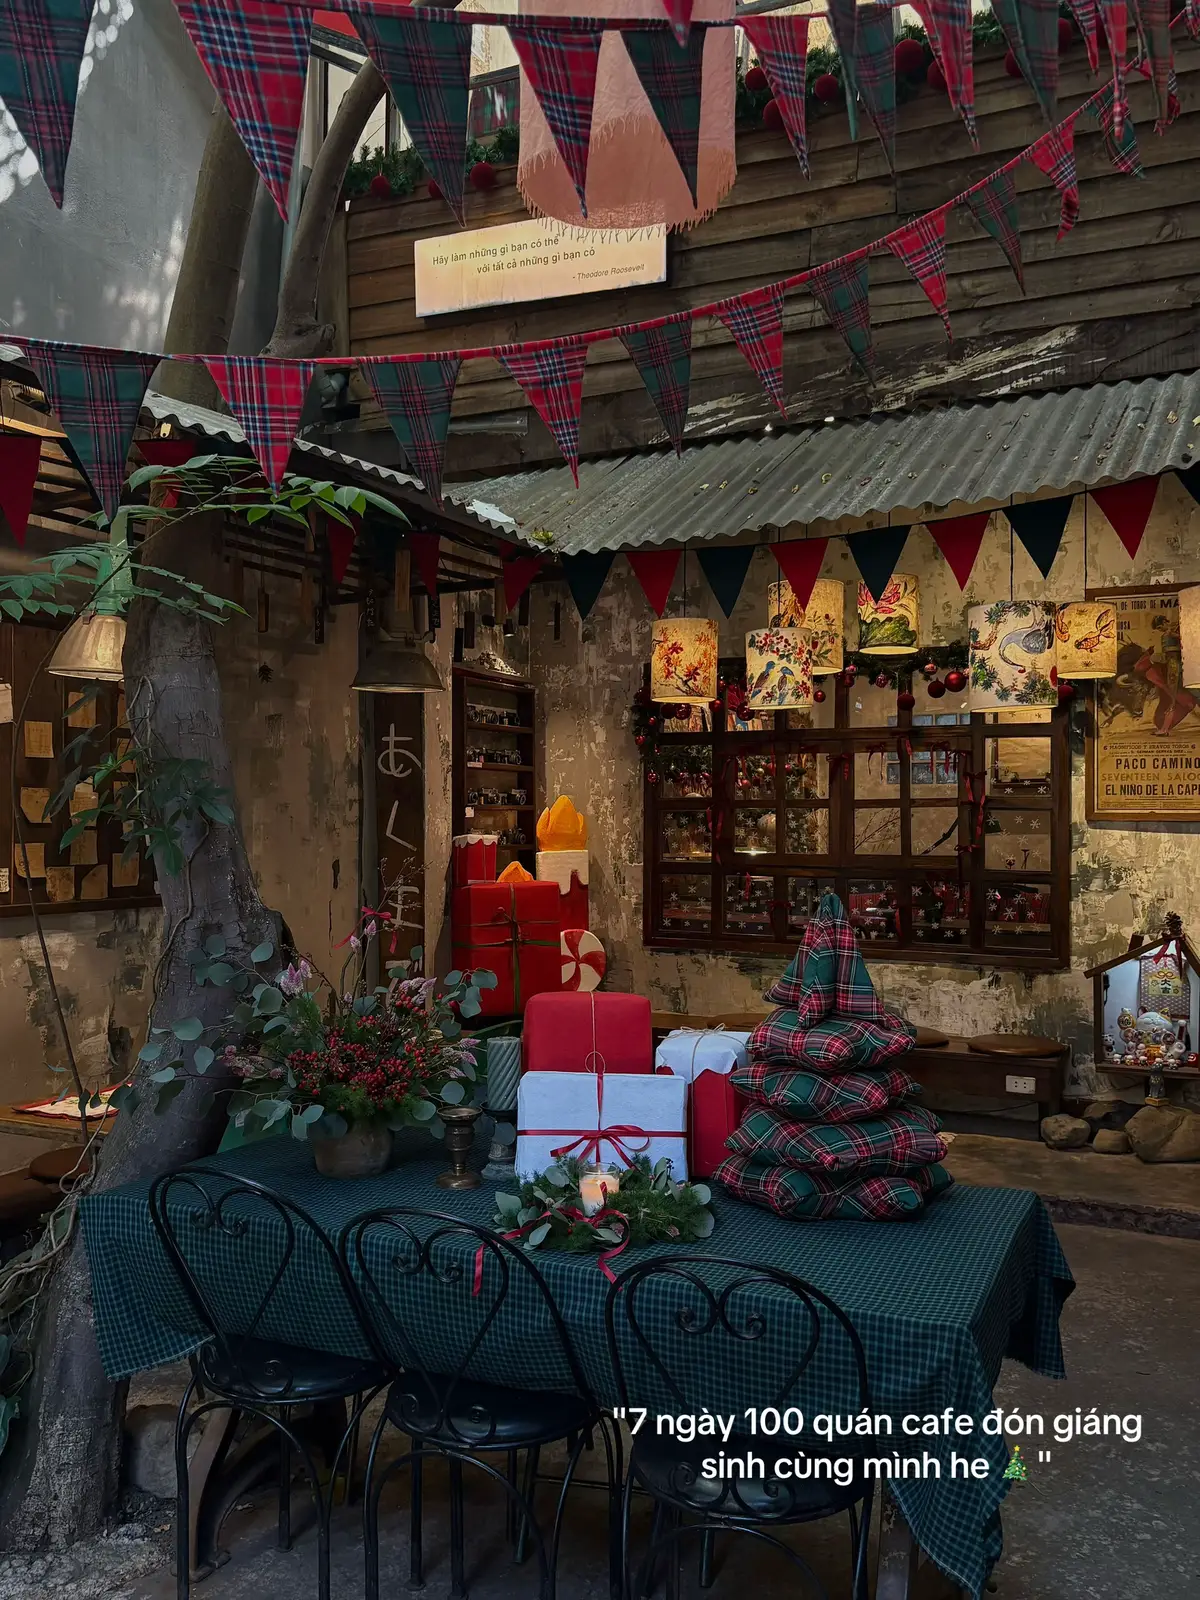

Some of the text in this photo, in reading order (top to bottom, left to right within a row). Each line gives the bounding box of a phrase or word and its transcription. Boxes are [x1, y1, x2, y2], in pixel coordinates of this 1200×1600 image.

[432, 234, 560, 266] Hãy làm những gì bạn có thể
[476, 246, 596, 274] với tất cả những gì bạn có
[577, 269, 609, 281] Theodore
[1115, 757, 1200, 770] PACO CAMINO
[1101, 772, 1160, 782] SEVENTEEN
[1105, 784, 1117, 796] EL
[1145, 784, 1158, 796] DE
[1161, 784, 1174, 796] LA
[1177, 783, 1200, 796] CAP
[1161, 979, 1171, 993] 大吉
